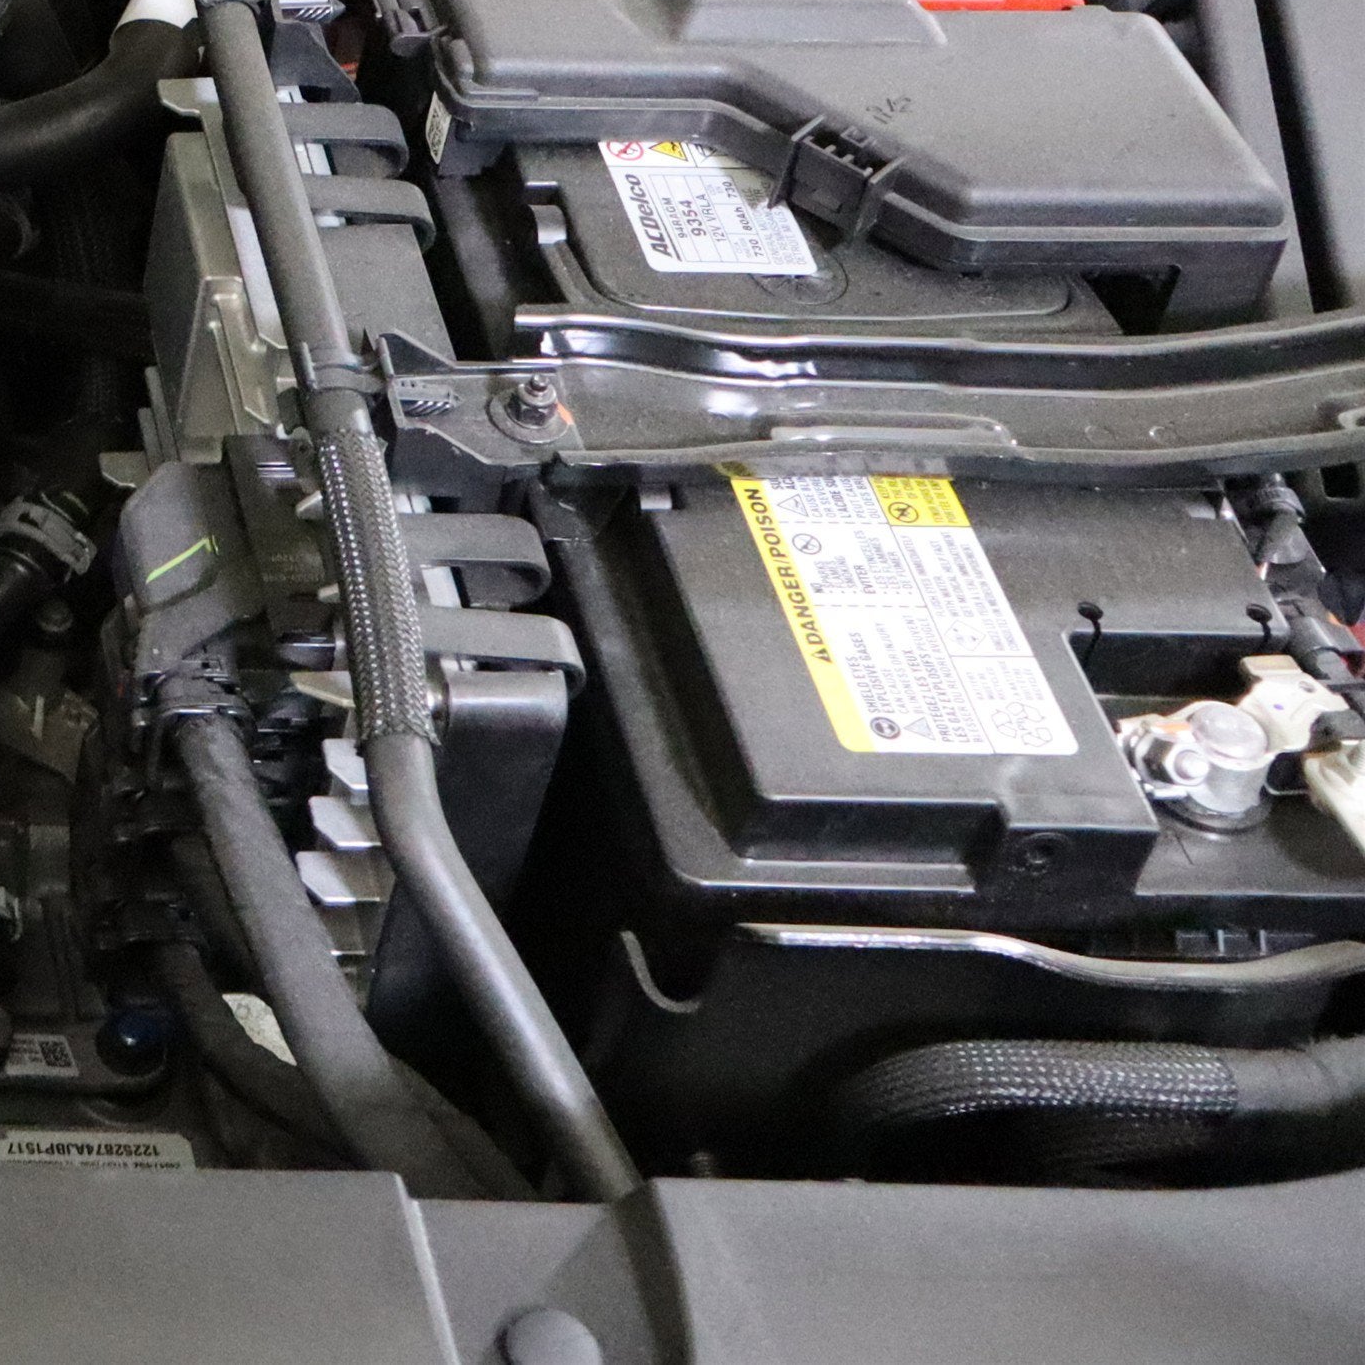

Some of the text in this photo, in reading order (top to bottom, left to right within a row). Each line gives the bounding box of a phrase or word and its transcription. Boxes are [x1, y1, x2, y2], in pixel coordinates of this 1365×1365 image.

[722, 181, 737, 198] 730
[626, 174, 671, 256] ACDelco
[679, 200, 706, 236] 9354
[696, 194, 726, 242] 12V VRLA
[734, 207, 752, 230] 80Ah
[749, 239, 764, 256] 730
[745, 489, 822, 644] DANGER/POISON
[849, 632, 895, 713] EXPLOSIVE GASES
